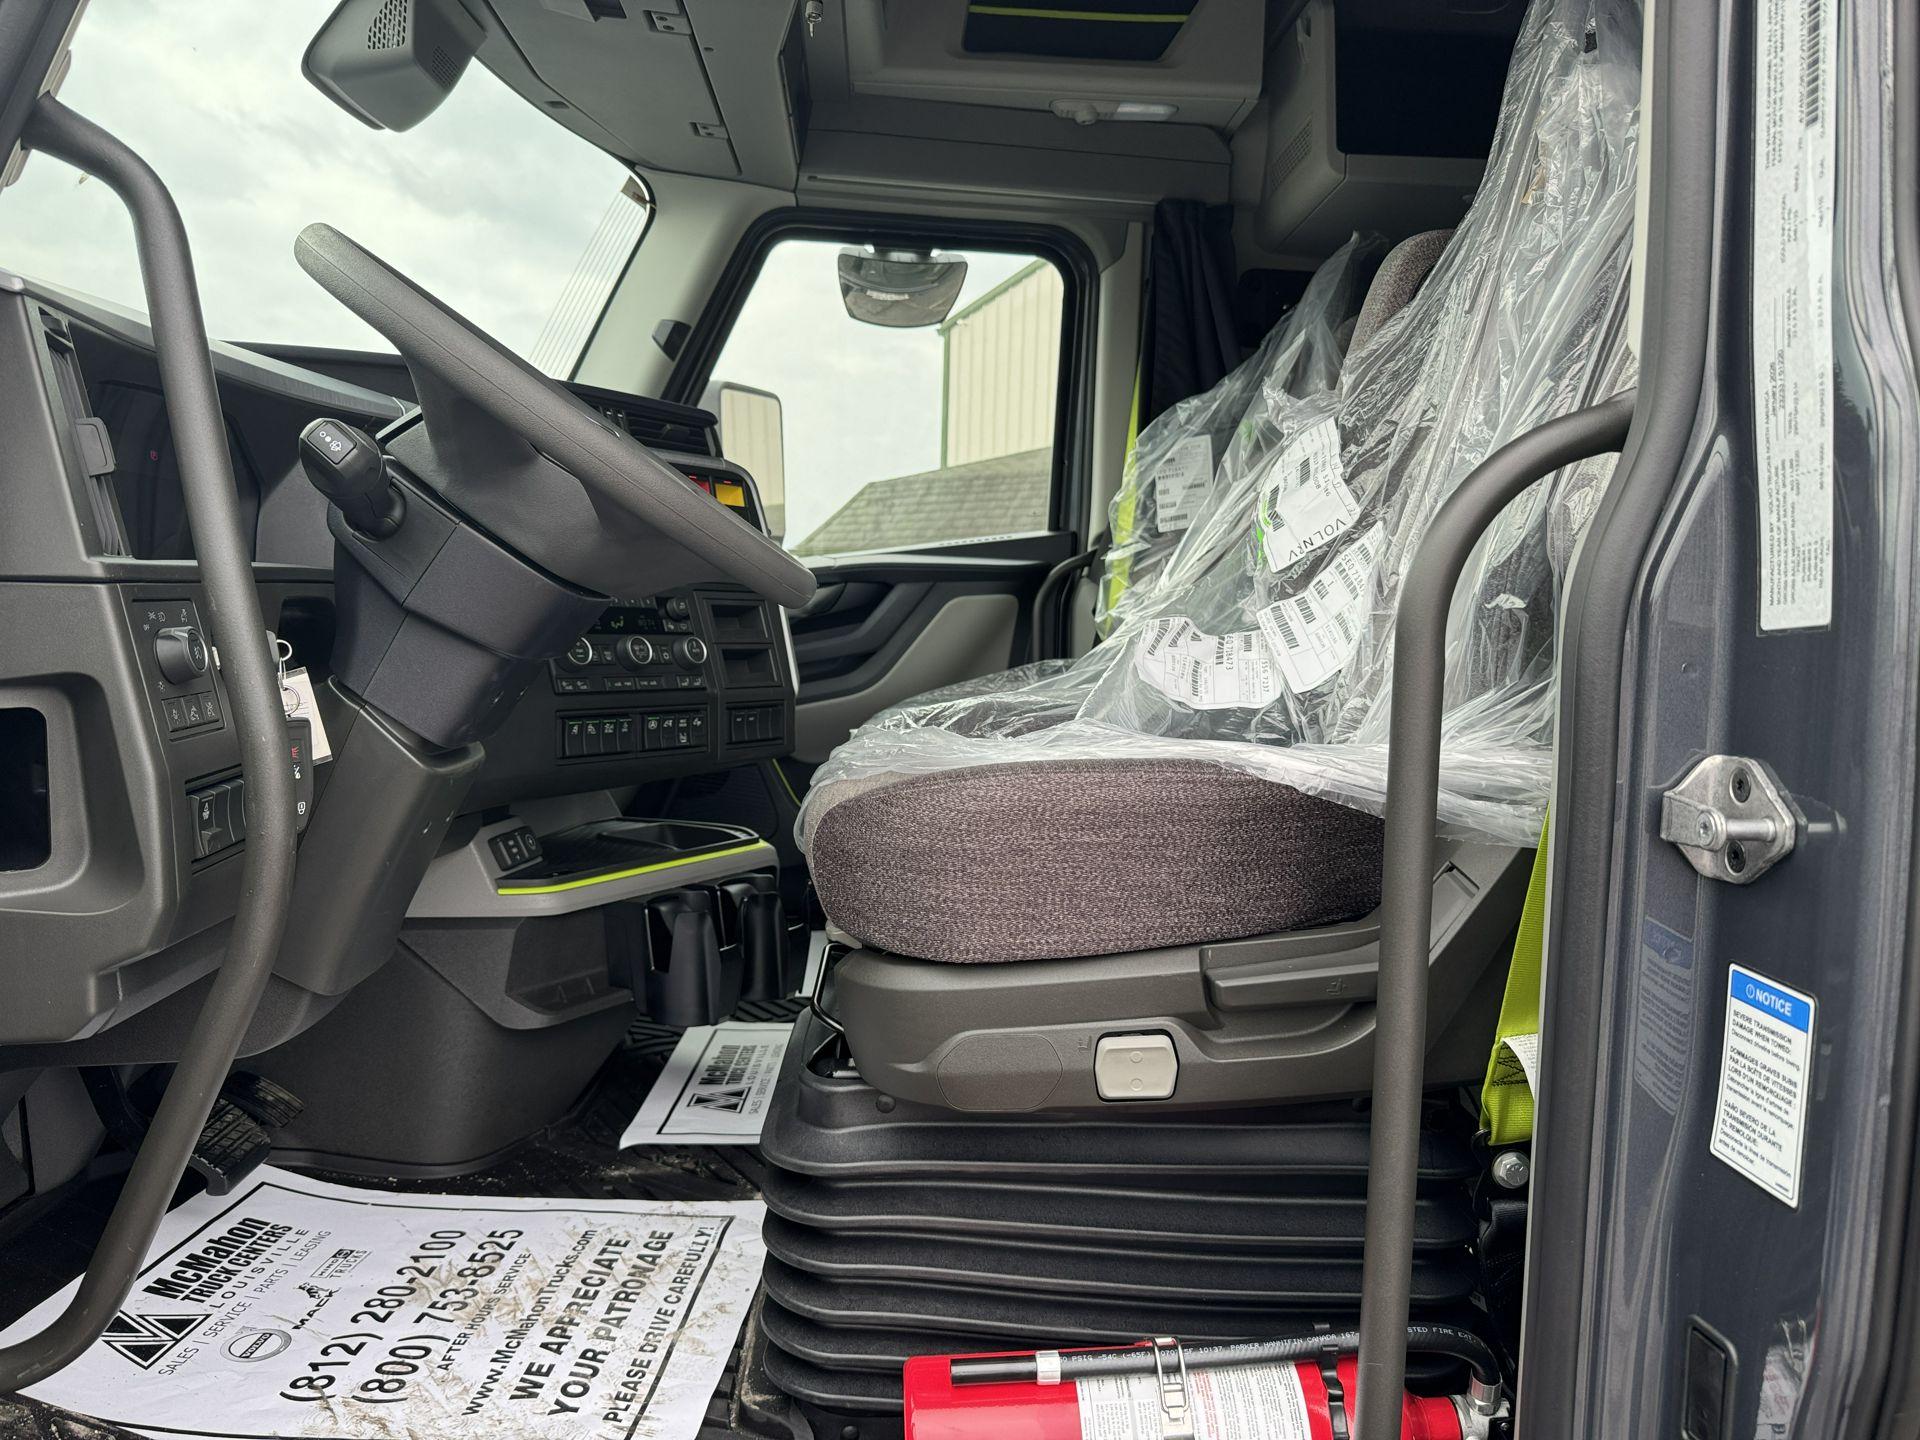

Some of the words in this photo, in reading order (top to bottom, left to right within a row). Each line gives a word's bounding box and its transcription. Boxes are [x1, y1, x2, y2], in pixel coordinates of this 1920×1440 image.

[1755, 988, 1792, 1017] NOTICE
[698, 1044, 740, 1085] McMahon
[142, 1217, 271, 1300] McMahon
[180, 1266, 242, 1304] TRUCK
[227, 1223, 293, 1268] CENTERS
[209, 1229, 309, 1309] LOUISVILLE
[329, 1250, 368, 1279] TRUCKS
[158, 1346, 199, 1376] SALES
[203, 1301, 252, 1338] SERVICE
[253, 1268, 289, 1294] PARTS
[294, 1230, 332, 1263] LEASING
[280, 1333, 384, 1401] (812)
[350, 1230, 466, 1323] 280-2100
[292, 1287, 342, 1329] MACK
[351, 1335, 451, 1403] (800)
[413, 1229, 524, 1323] 753-8525
[437, 1331, 472, 1371] AFTER
[470, 1297, 499, 1331] HOURS
[494, 1253, 531, 1294] SERVICE
[461, 1229, 597, 1416] www.McMahonTrucks.com
[509, 1362, 555, 1401] WE
[539, 1238, 631, 1355] APPRECIATE
[547, 1348, 610, 1416] YOUR
[593, 1230, 674, 1342] PATRONAGE
[602, 1351, 652, 1423] PLEASE
[638, 1307, 676, 1354] DRIVE
[664, 1226, 715, 1305] CAREFULLY!
[1072, 1352, 1093, 1361] PSIG
[1230, 1343, 1259, 1352] PARKER
[1263, 1338, 1303, 1349] HANNIFIN
[1306, 1334, 1337, 1344] CANADA
[1432, 1327, 1454, 1335] FIRE
[242, 1333, 271, 1358] VOLVO
